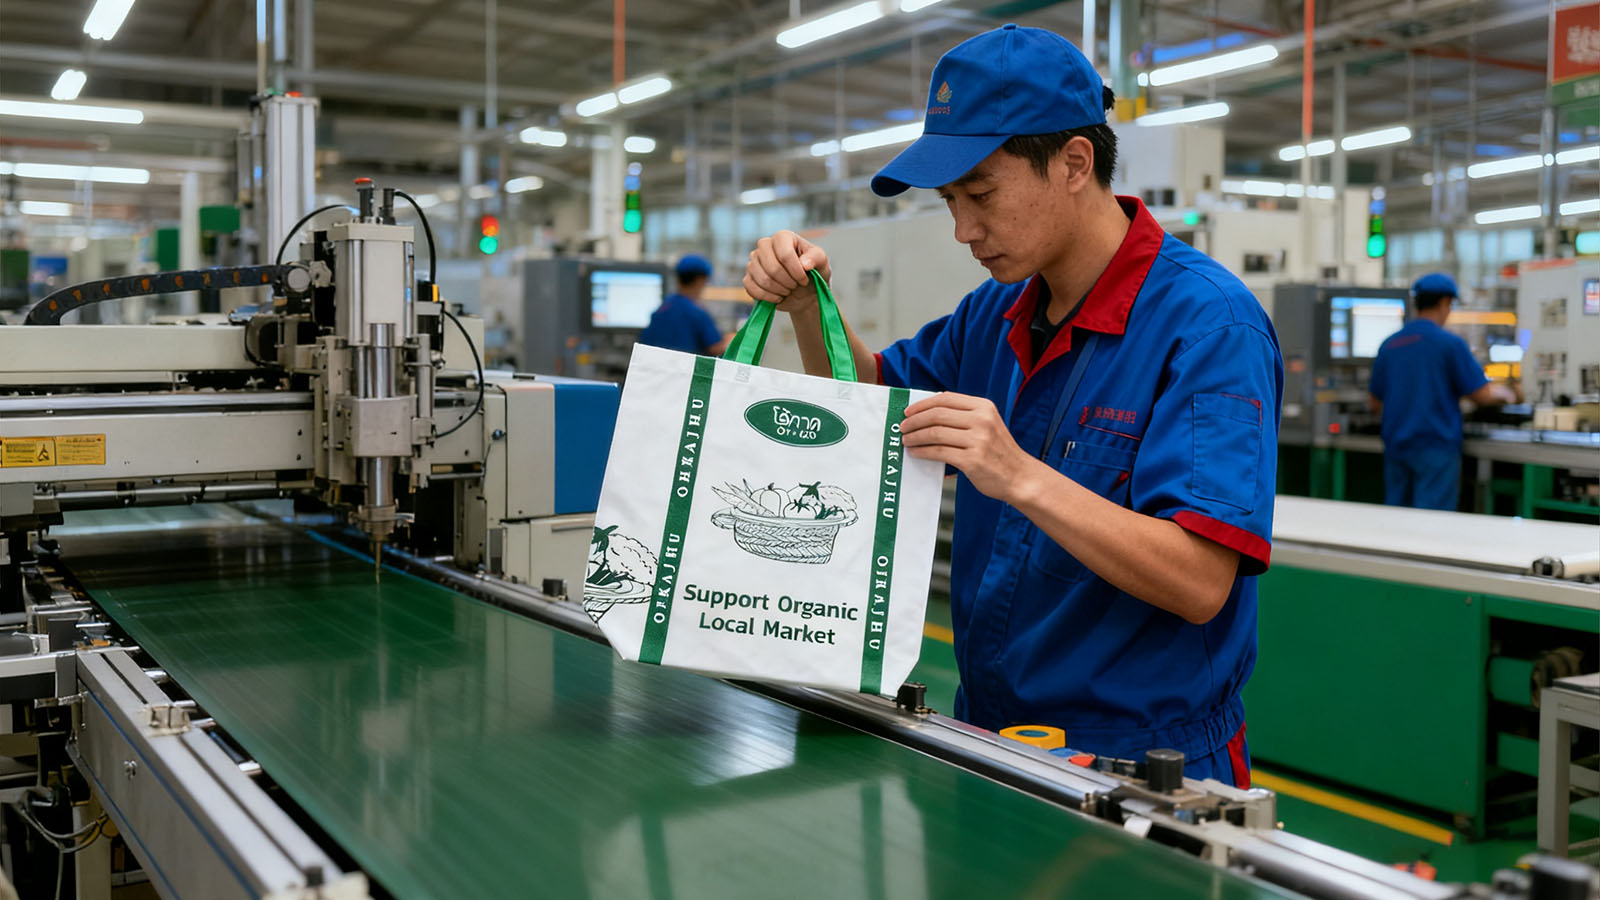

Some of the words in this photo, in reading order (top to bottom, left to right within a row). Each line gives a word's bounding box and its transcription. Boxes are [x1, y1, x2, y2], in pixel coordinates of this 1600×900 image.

[683, 584, 770, 610] Support
[778, 595, 859, 621] Organic
[699, 611, 755, 635] Local
[763, 619, 836, 645] Market
